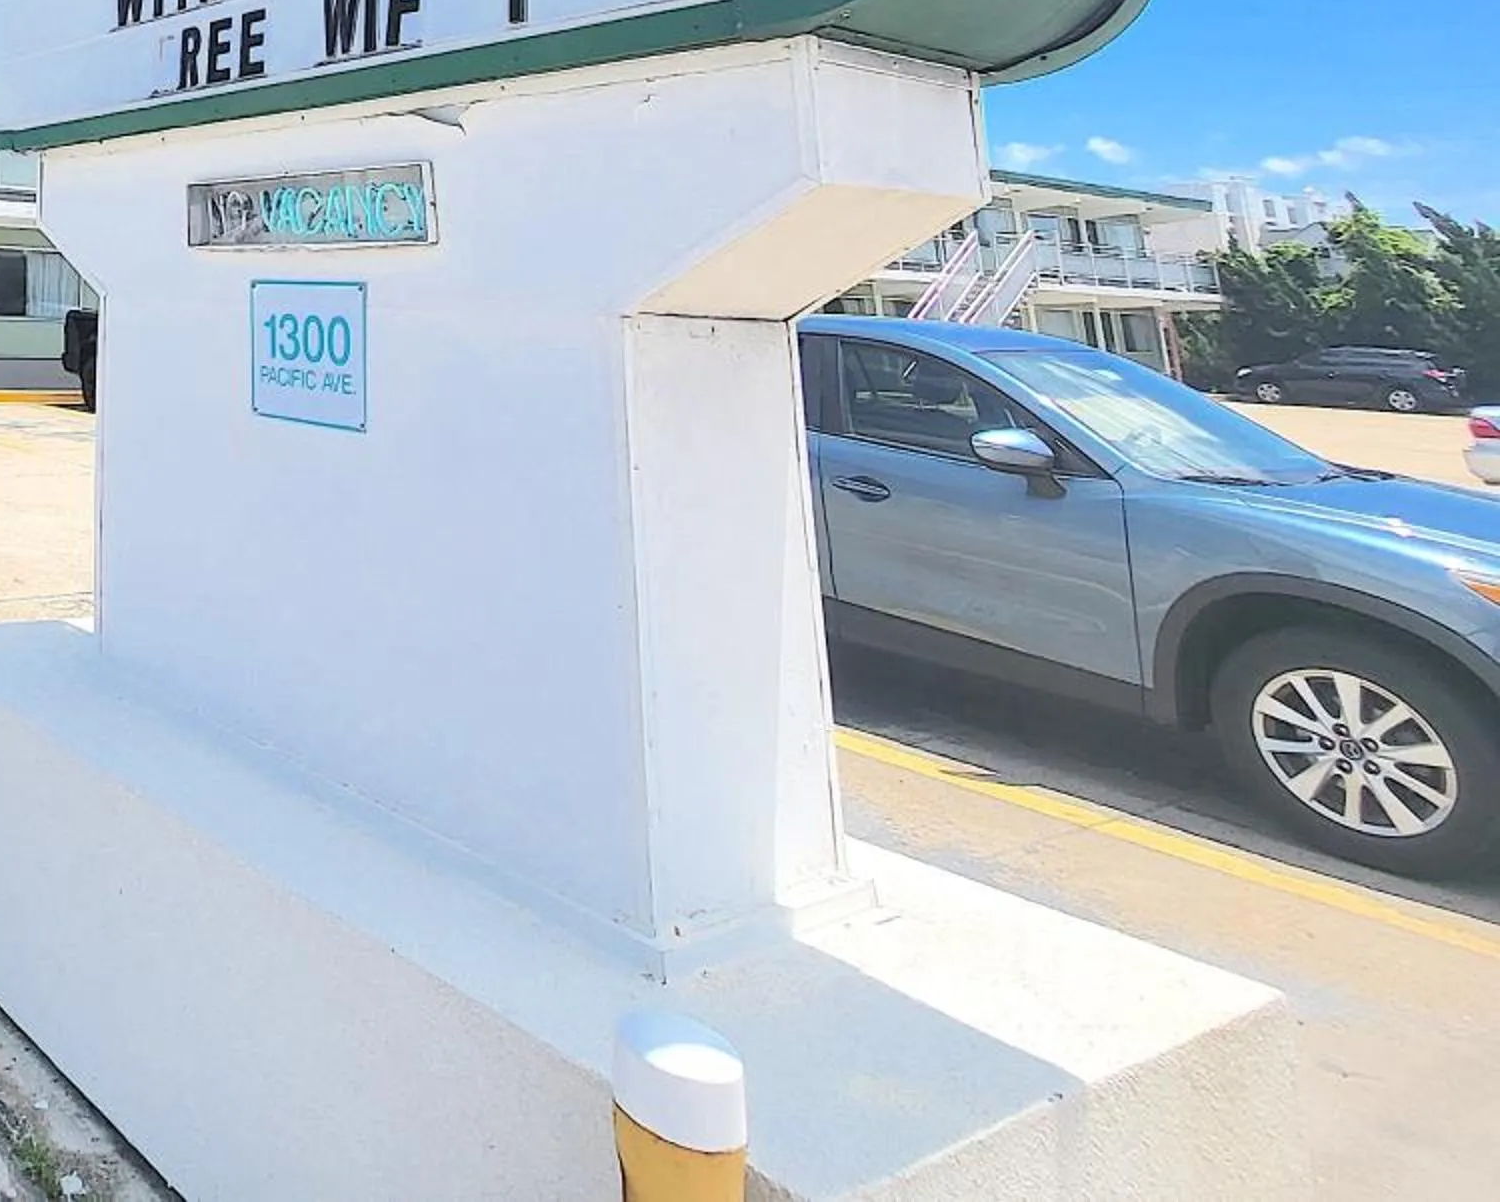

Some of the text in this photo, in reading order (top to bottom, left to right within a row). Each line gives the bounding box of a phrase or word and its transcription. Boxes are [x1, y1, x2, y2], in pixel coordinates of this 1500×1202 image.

[261, 182, 426, 237] VACANCY
[263, 313, 352, 367] 1300
[260, 365, 357, 396] PACIFIC AVE.
